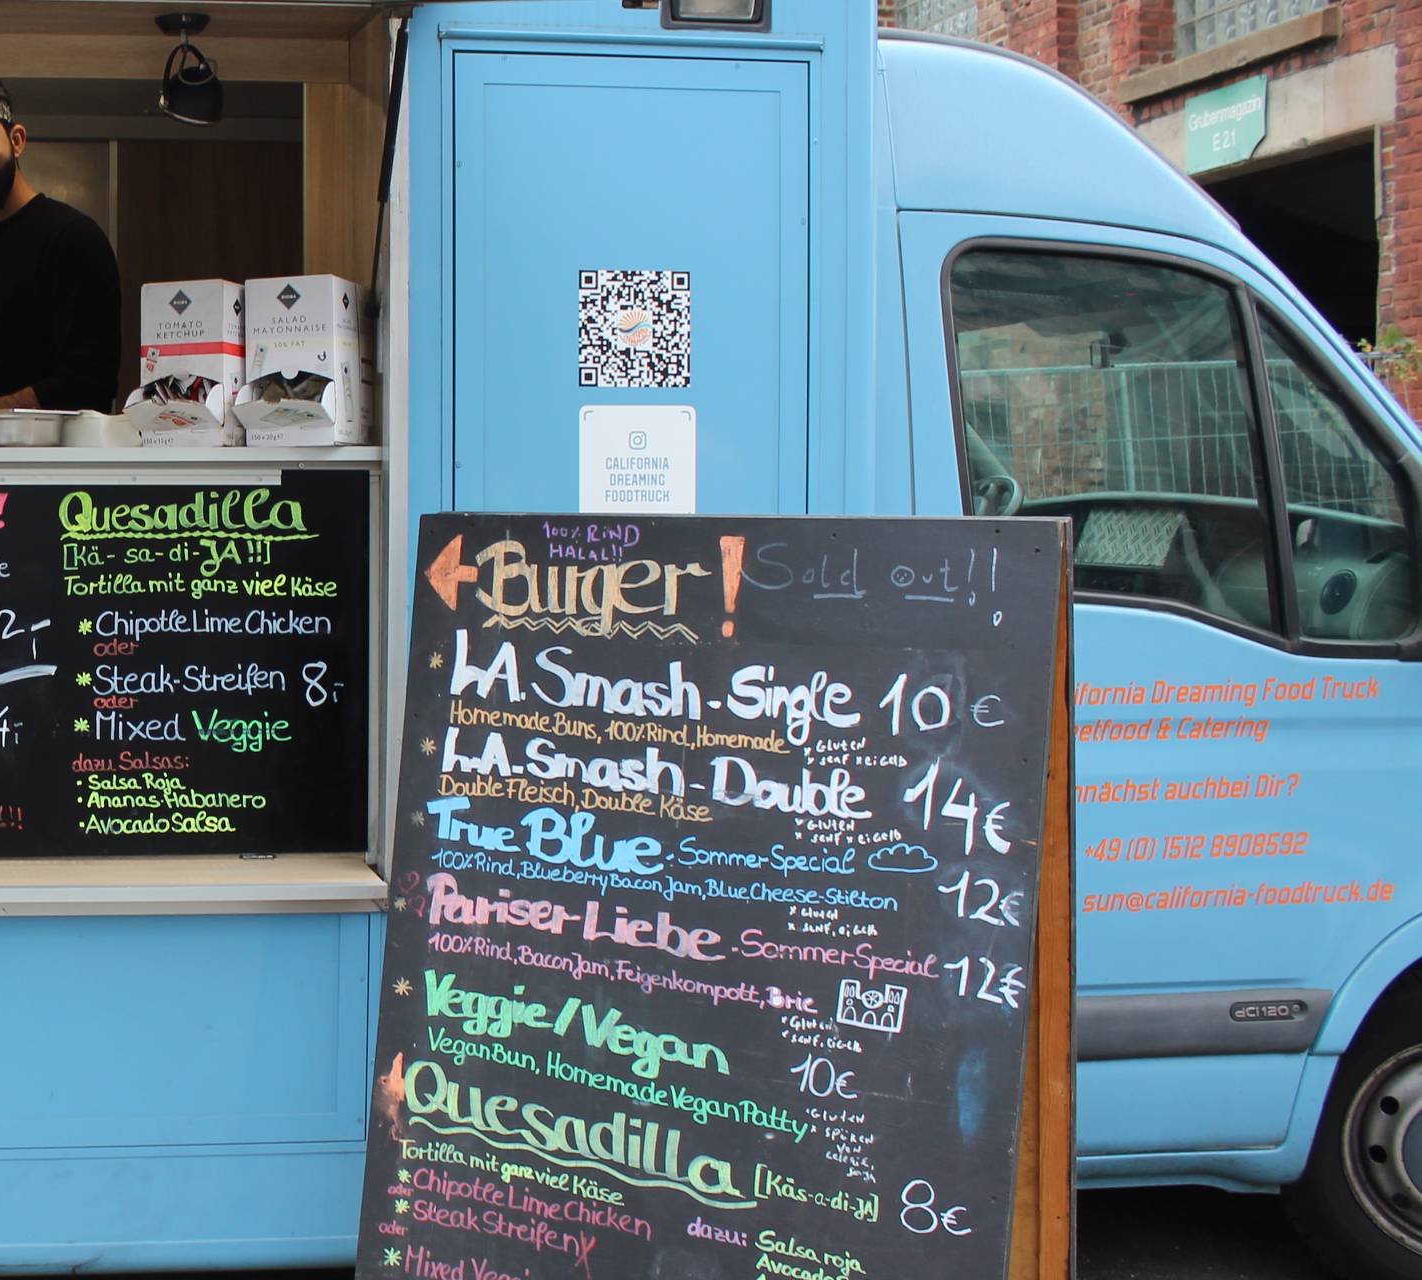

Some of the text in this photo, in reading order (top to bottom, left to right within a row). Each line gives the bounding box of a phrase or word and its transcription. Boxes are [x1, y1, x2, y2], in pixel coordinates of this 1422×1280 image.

[156, 330, 205, 340] KETCHUP
[158, 320, 204, 331] TOMATO
[253, 324, 327, 335] MAYONNAISE
[271, 315, 307, 325] SALAD
[605, 457, 670, 470] CALIFORNIA
[609, 473, 666, 486] DREAMING
[58, 487, 308, 534] Quesadilla
[605, 490, 670, 502] FOODTRUCK
[64, 571, 338, 600] Tortilla mit ganz viel Käse
[740, 542, 867, 597] Sold
[475, 539, 713, 638] Burger
[95, 608, 332, 641] Chipotle Lime Chicken
[93, 638, 139, 657] oder
[93, 695, 139, 709] oder
[530, 646, 951, 738] Smash 10
[1151, 680, 1259, 708] Dreaming
[1261, 677, 1317, 701] Food
[1321, 675, 1381, 700] Truck
[95, 708, 292, 753] Mixed Veggie
[449, 700, 553, 732] Homemade
[696, 725, 791, 754] Homemade
[1155, 717, 1173, 740] &
[1177, 715, 1272, 743] Catering
[71, 753, 116, 773] dazu
[525, 737, 685, 797] Smash
[87, 772, 187, 796] Salsa Roja
[437, 774, 714, 823] Double Double Käse
[1164, 775, 1252, 801] auchbei
[1254, 773, 1301, 799] Dir?
[84, 810, 237, 836] Avocado Salsa
[426, 796, 522, 852] True
[520, 806, 665, 876] Blue
[1161, 834, 1207, 861] 1512
[1209, 830, 1310, 859] 8908592
[519, 860, 611, 897] Blueberry
[1081, 878, 1396, 913] sun@california-foodtruck.de
[426, 871, 727, 962] Pariser Liebe
[427, 1025, 808, 1144] Vegan Homemade Vegan Patty
[403, 1060, 747, 1200] Quesadilla
[399, 1138, 626, 1207] Tortilla mit ganz viel Käse
[412, 1168, 653, 1242] Chipotle Lime Chicken
[412, 1199, 482, 1233] Steak
[754, 1229, 822, 1264] Salsa
